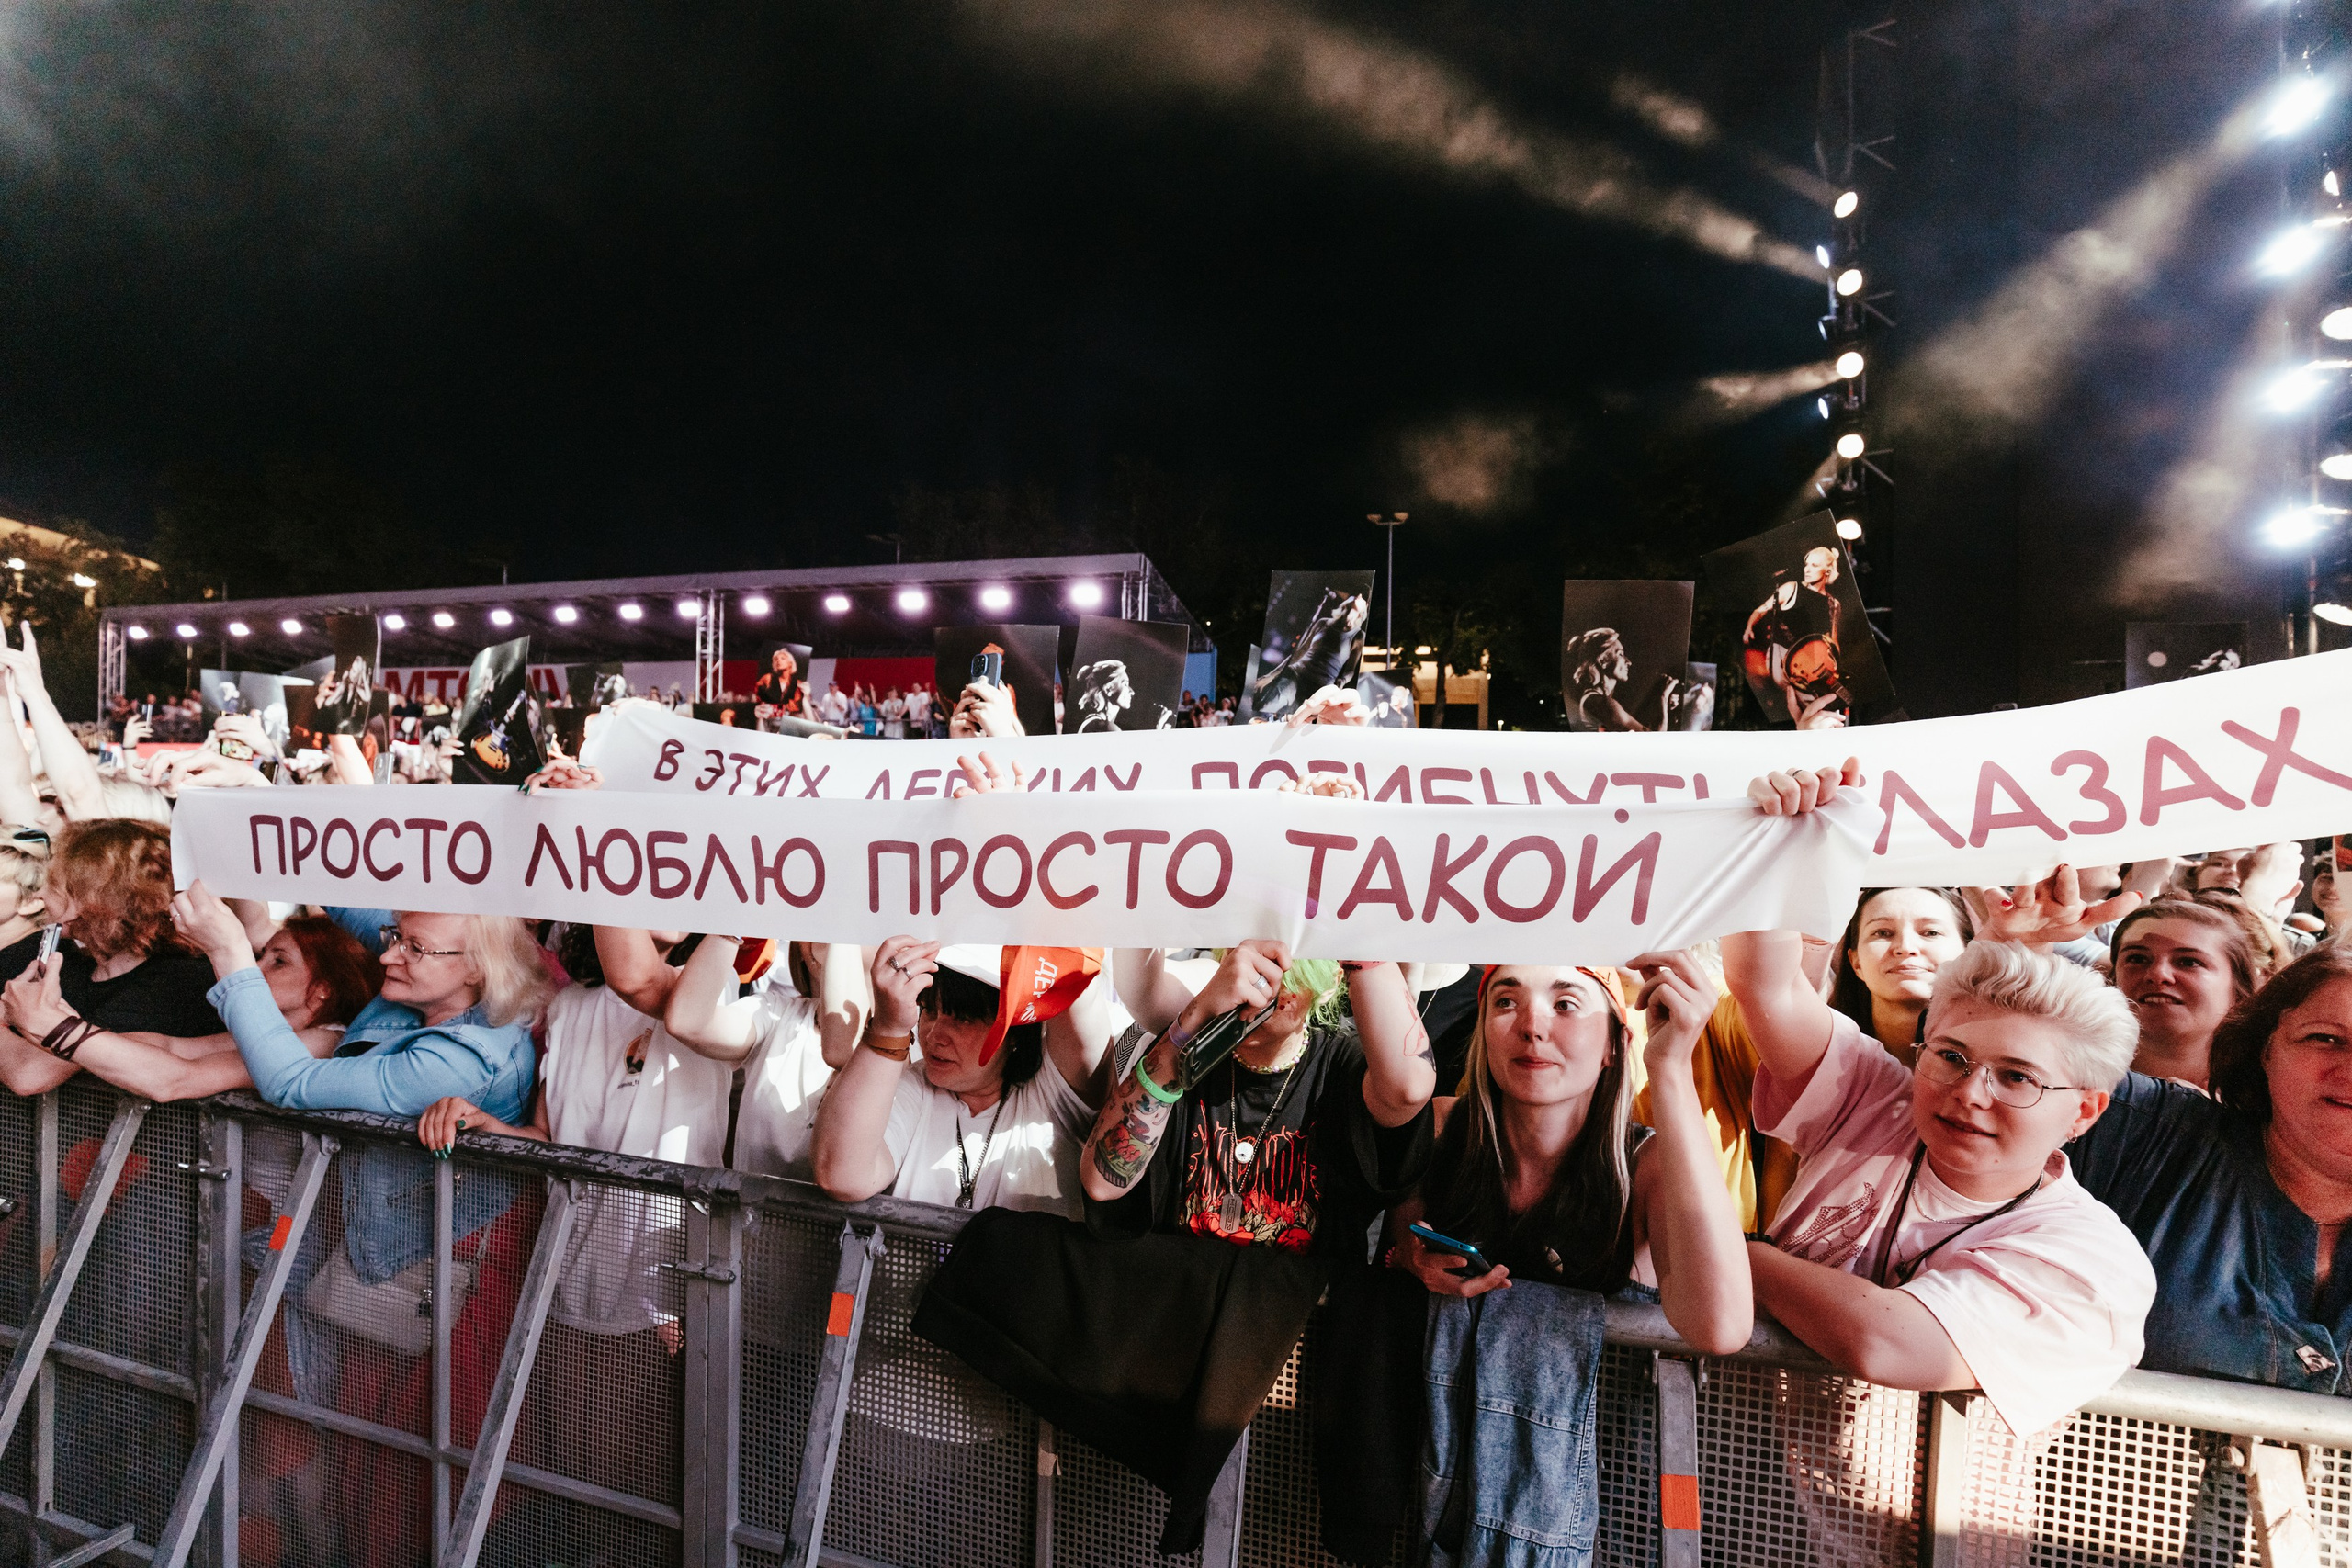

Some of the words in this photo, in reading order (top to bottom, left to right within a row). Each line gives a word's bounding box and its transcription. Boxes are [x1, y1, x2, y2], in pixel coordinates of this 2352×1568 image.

[654, 739, 684, 781] В
[695, 749, 831, 798] ЭТИХ
[1860, 707, 2352, 855] ЛАЗАХ
[250, 815, 491, 884] ПРОСТО
[525, 822, 826, 908] ЛЮБЛЮ
[868, 830, 1232, 915] ПРОСТО
[1286, 809, 1661, 925] ТАКОЙ
